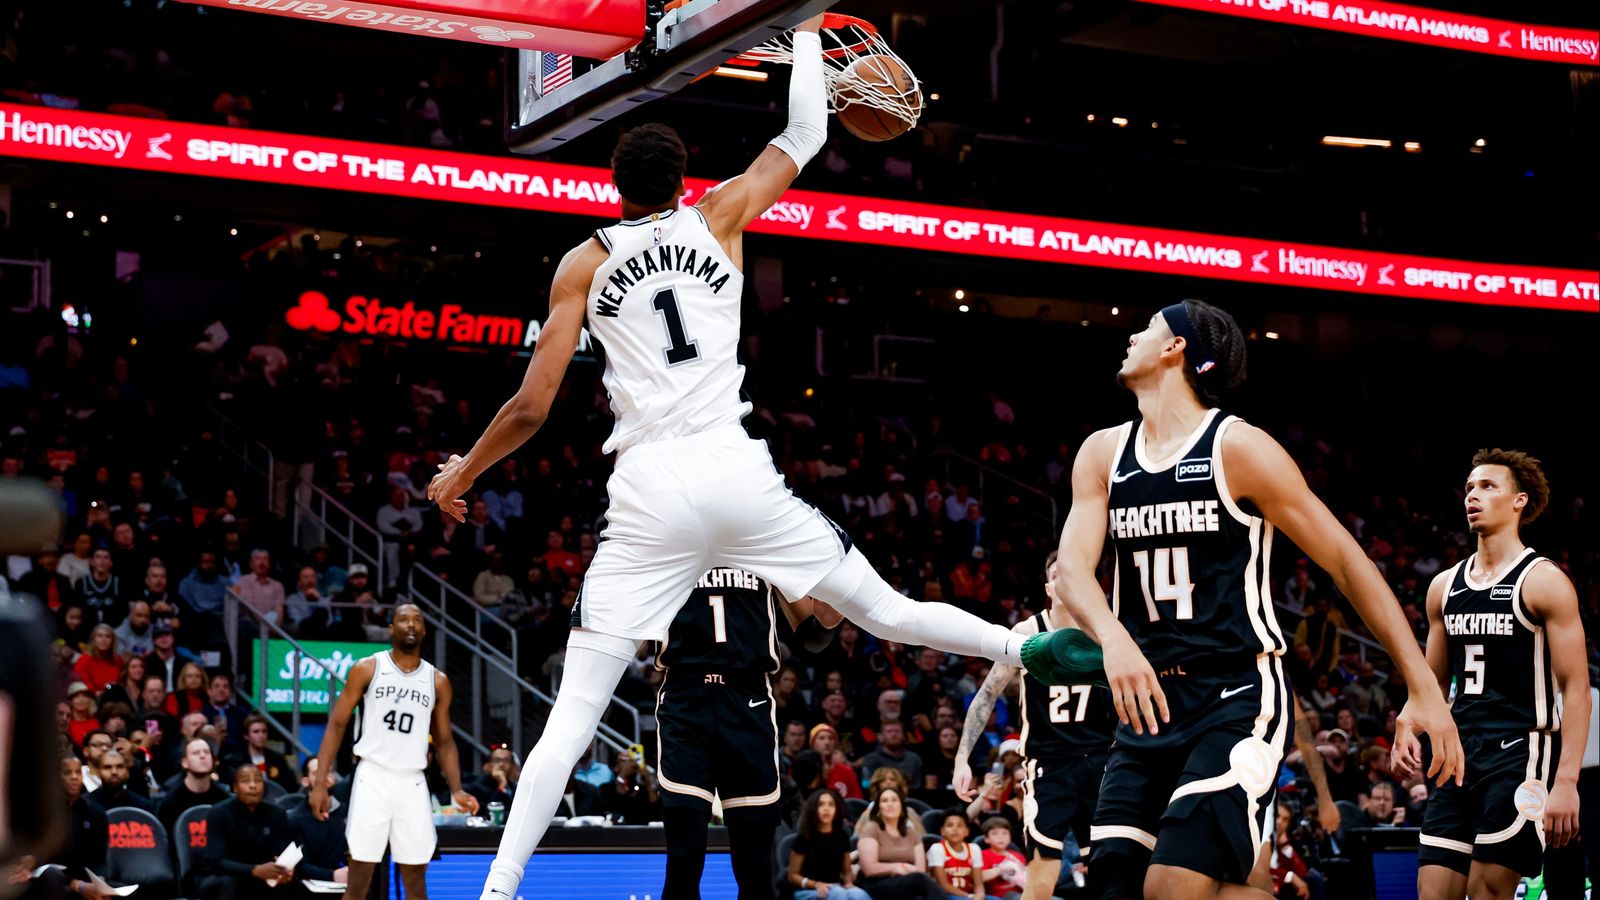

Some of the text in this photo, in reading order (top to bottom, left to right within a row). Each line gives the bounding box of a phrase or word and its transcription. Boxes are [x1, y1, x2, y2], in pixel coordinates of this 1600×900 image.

[1289, 0, 1329, 18] THE
[1332, 5, 1419, 32] ATLANTA
[1421, 18, 1489, 43] HAWKS
[1521, 28, 1598, 60] Hennessy
[0, 111, 622, 205] Hennessy SPIRIT OF THE ATLANTA HAW
[858, 210, 941, 237] SPIRIT
[943, 219, 980, 241] OF
[983, 224, 1035, 247] THE
[1039, 230, 1153, 260] ATLANTA
[1154, 240, 1243, 269] HAWKS
[1278, 248, 1368, 287] Hennessy
[1404, 267, 1473, 291] SPIRIT
[1474, 274, 1507, 295] OF
[1508, 276, 1558, 298] THE
[596, 245, 730, 318] WEMBANYAMA
[650, 284, 703, 369] 1
[1179, 463, 1210, 477] paze
[1133, 547, 1195, 622] 14
[708, 595, 727, 643] 1
[279, 650, 356, 680] Sprit
[704, 674, 725, 685] ATL
[1463, 644, 1486, 695] 5
[375, 686, 430, 708] SPURS
[1049, 685, 1092, 723] 27
[383, 710, 414, 734] 40
[108, 821, 154, 837] PAPA
